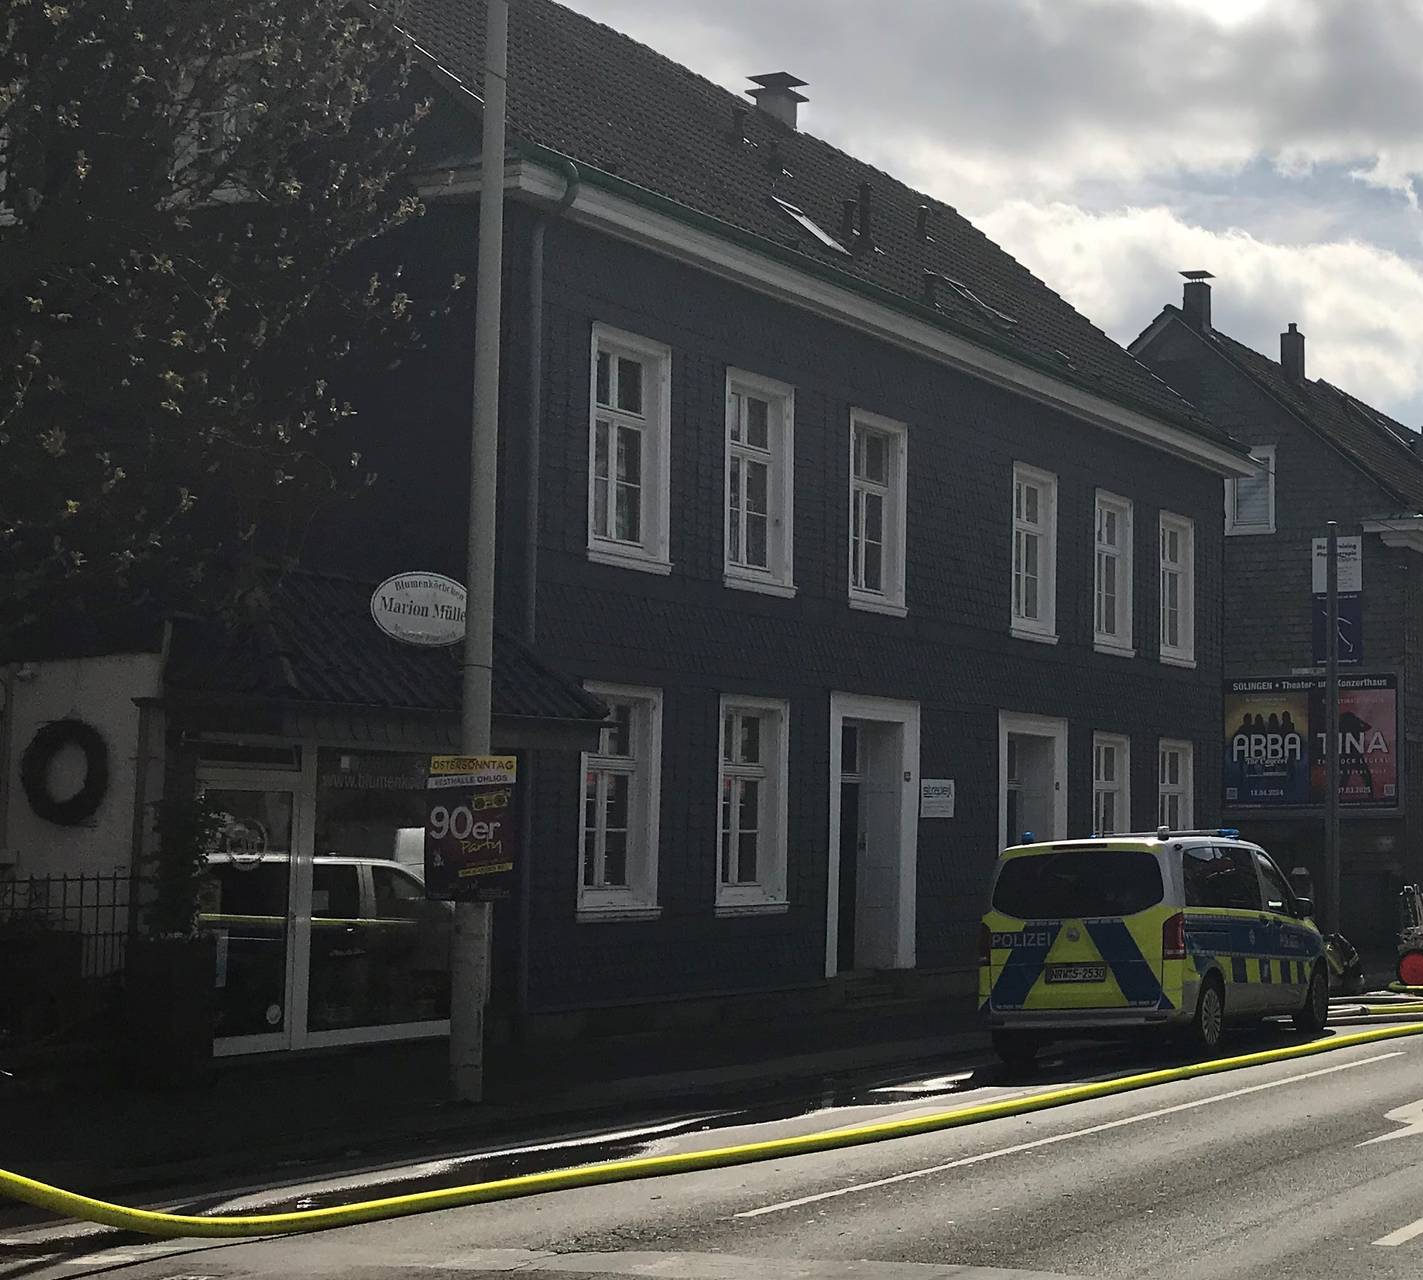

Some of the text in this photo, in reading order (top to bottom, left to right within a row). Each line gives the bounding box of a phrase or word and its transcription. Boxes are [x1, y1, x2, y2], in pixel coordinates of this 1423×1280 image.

[381, 596, 466, 622] Marion Mülle
[1233, 681, 1272, 691] SOLINGEN
[1281, 680, 1316, 690] Theater-
[1232, 733, 1301, 763] ABBA
[1316, 731, 1389, 755] TINA
[433, 760, 514, 770] OSTERSONNTAG
[429, 805, 501, 840] 90er
[461, 838, 503, 855] Party
[991, 932, 1051, 948] POLIZEI
